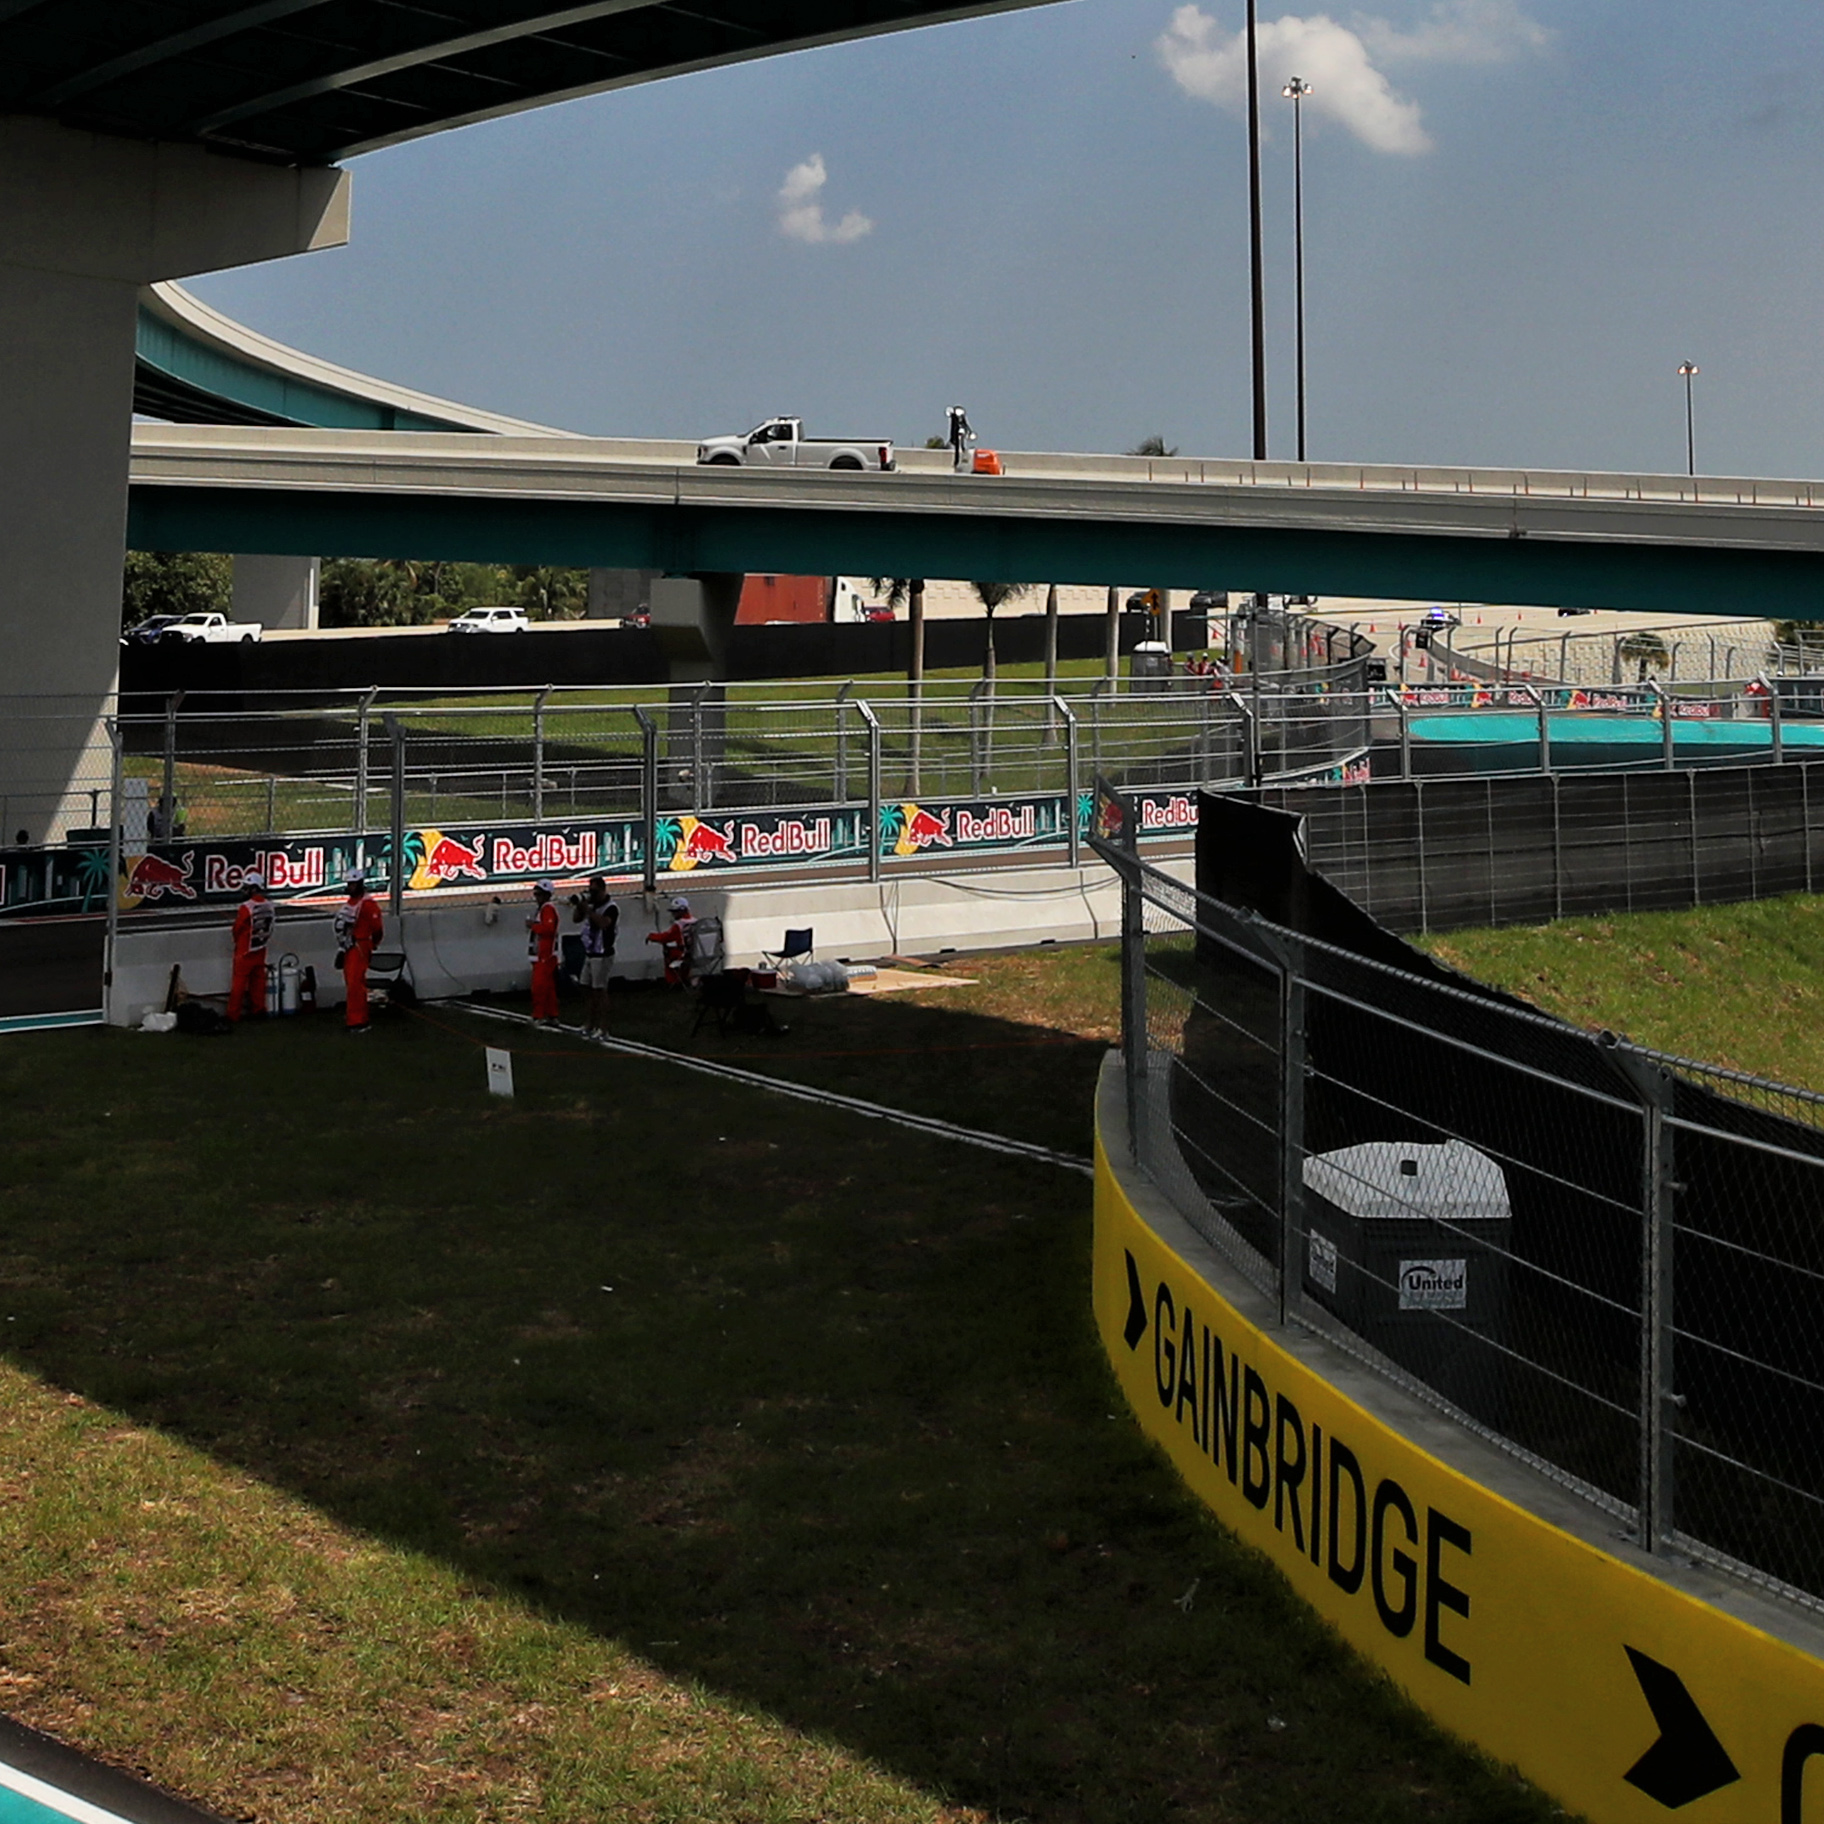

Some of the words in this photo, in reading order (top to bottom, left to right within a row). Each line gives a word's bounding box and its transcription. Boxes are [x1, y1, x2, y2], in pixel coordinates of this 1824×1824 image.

[957, 808, 996, 842] Red
[996, 805, 1034, 839] Bull
[1142, 796, 1176, 829] Red
[1176, 797, 1199, 826] Bu
[493, 834, 546, 874] Red
[547, 831, 596, 870] Bull
[741, 820, 786, 857] Red
[787, 817, 830, 854] Bull
[266, 847, 324, 889] Bull
[1408, 1274, 1464, 1292] United
[1154, 1281, 1472, 1687] GAINBRIDGE
